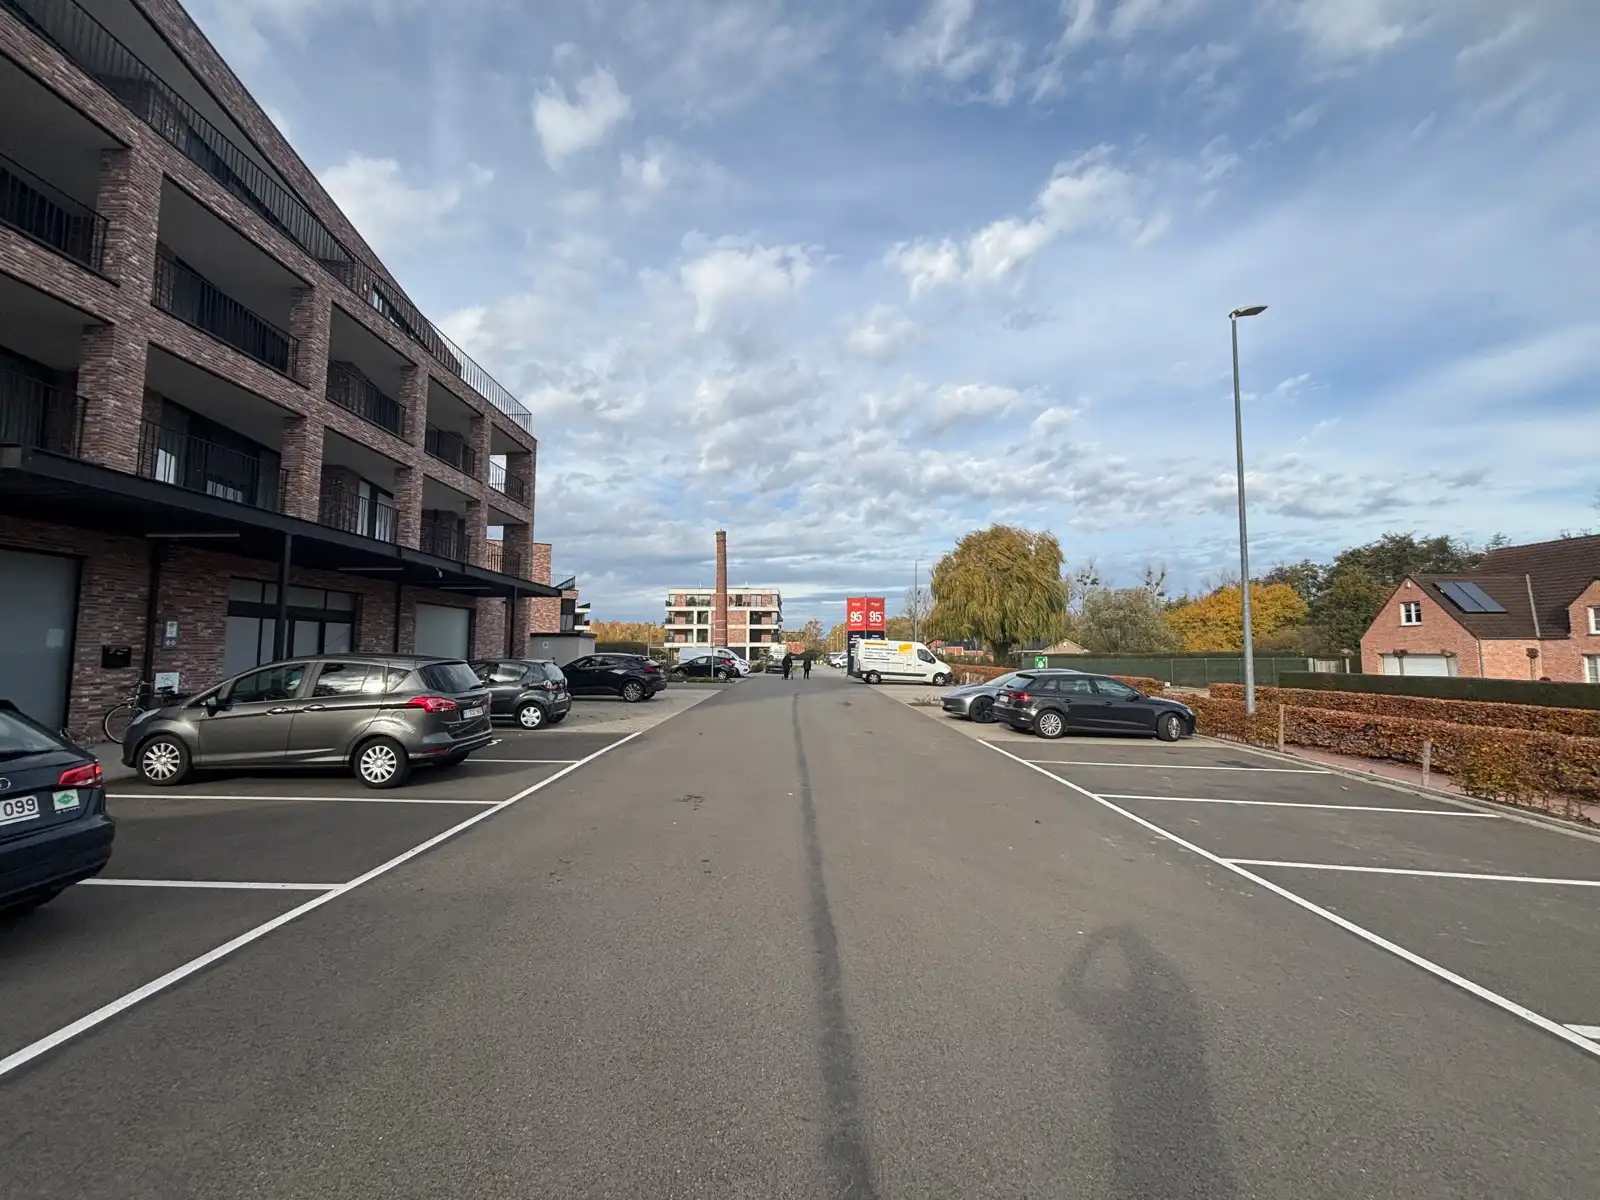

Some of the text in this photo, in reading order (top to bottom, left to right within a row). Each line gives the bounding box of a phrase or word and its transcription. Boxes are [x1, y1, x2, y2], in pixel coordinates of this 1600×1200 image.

[850, 610, 862, 622] 95
[869, 610, 882, 622] 95
[4, 797, 36, 817] 099
